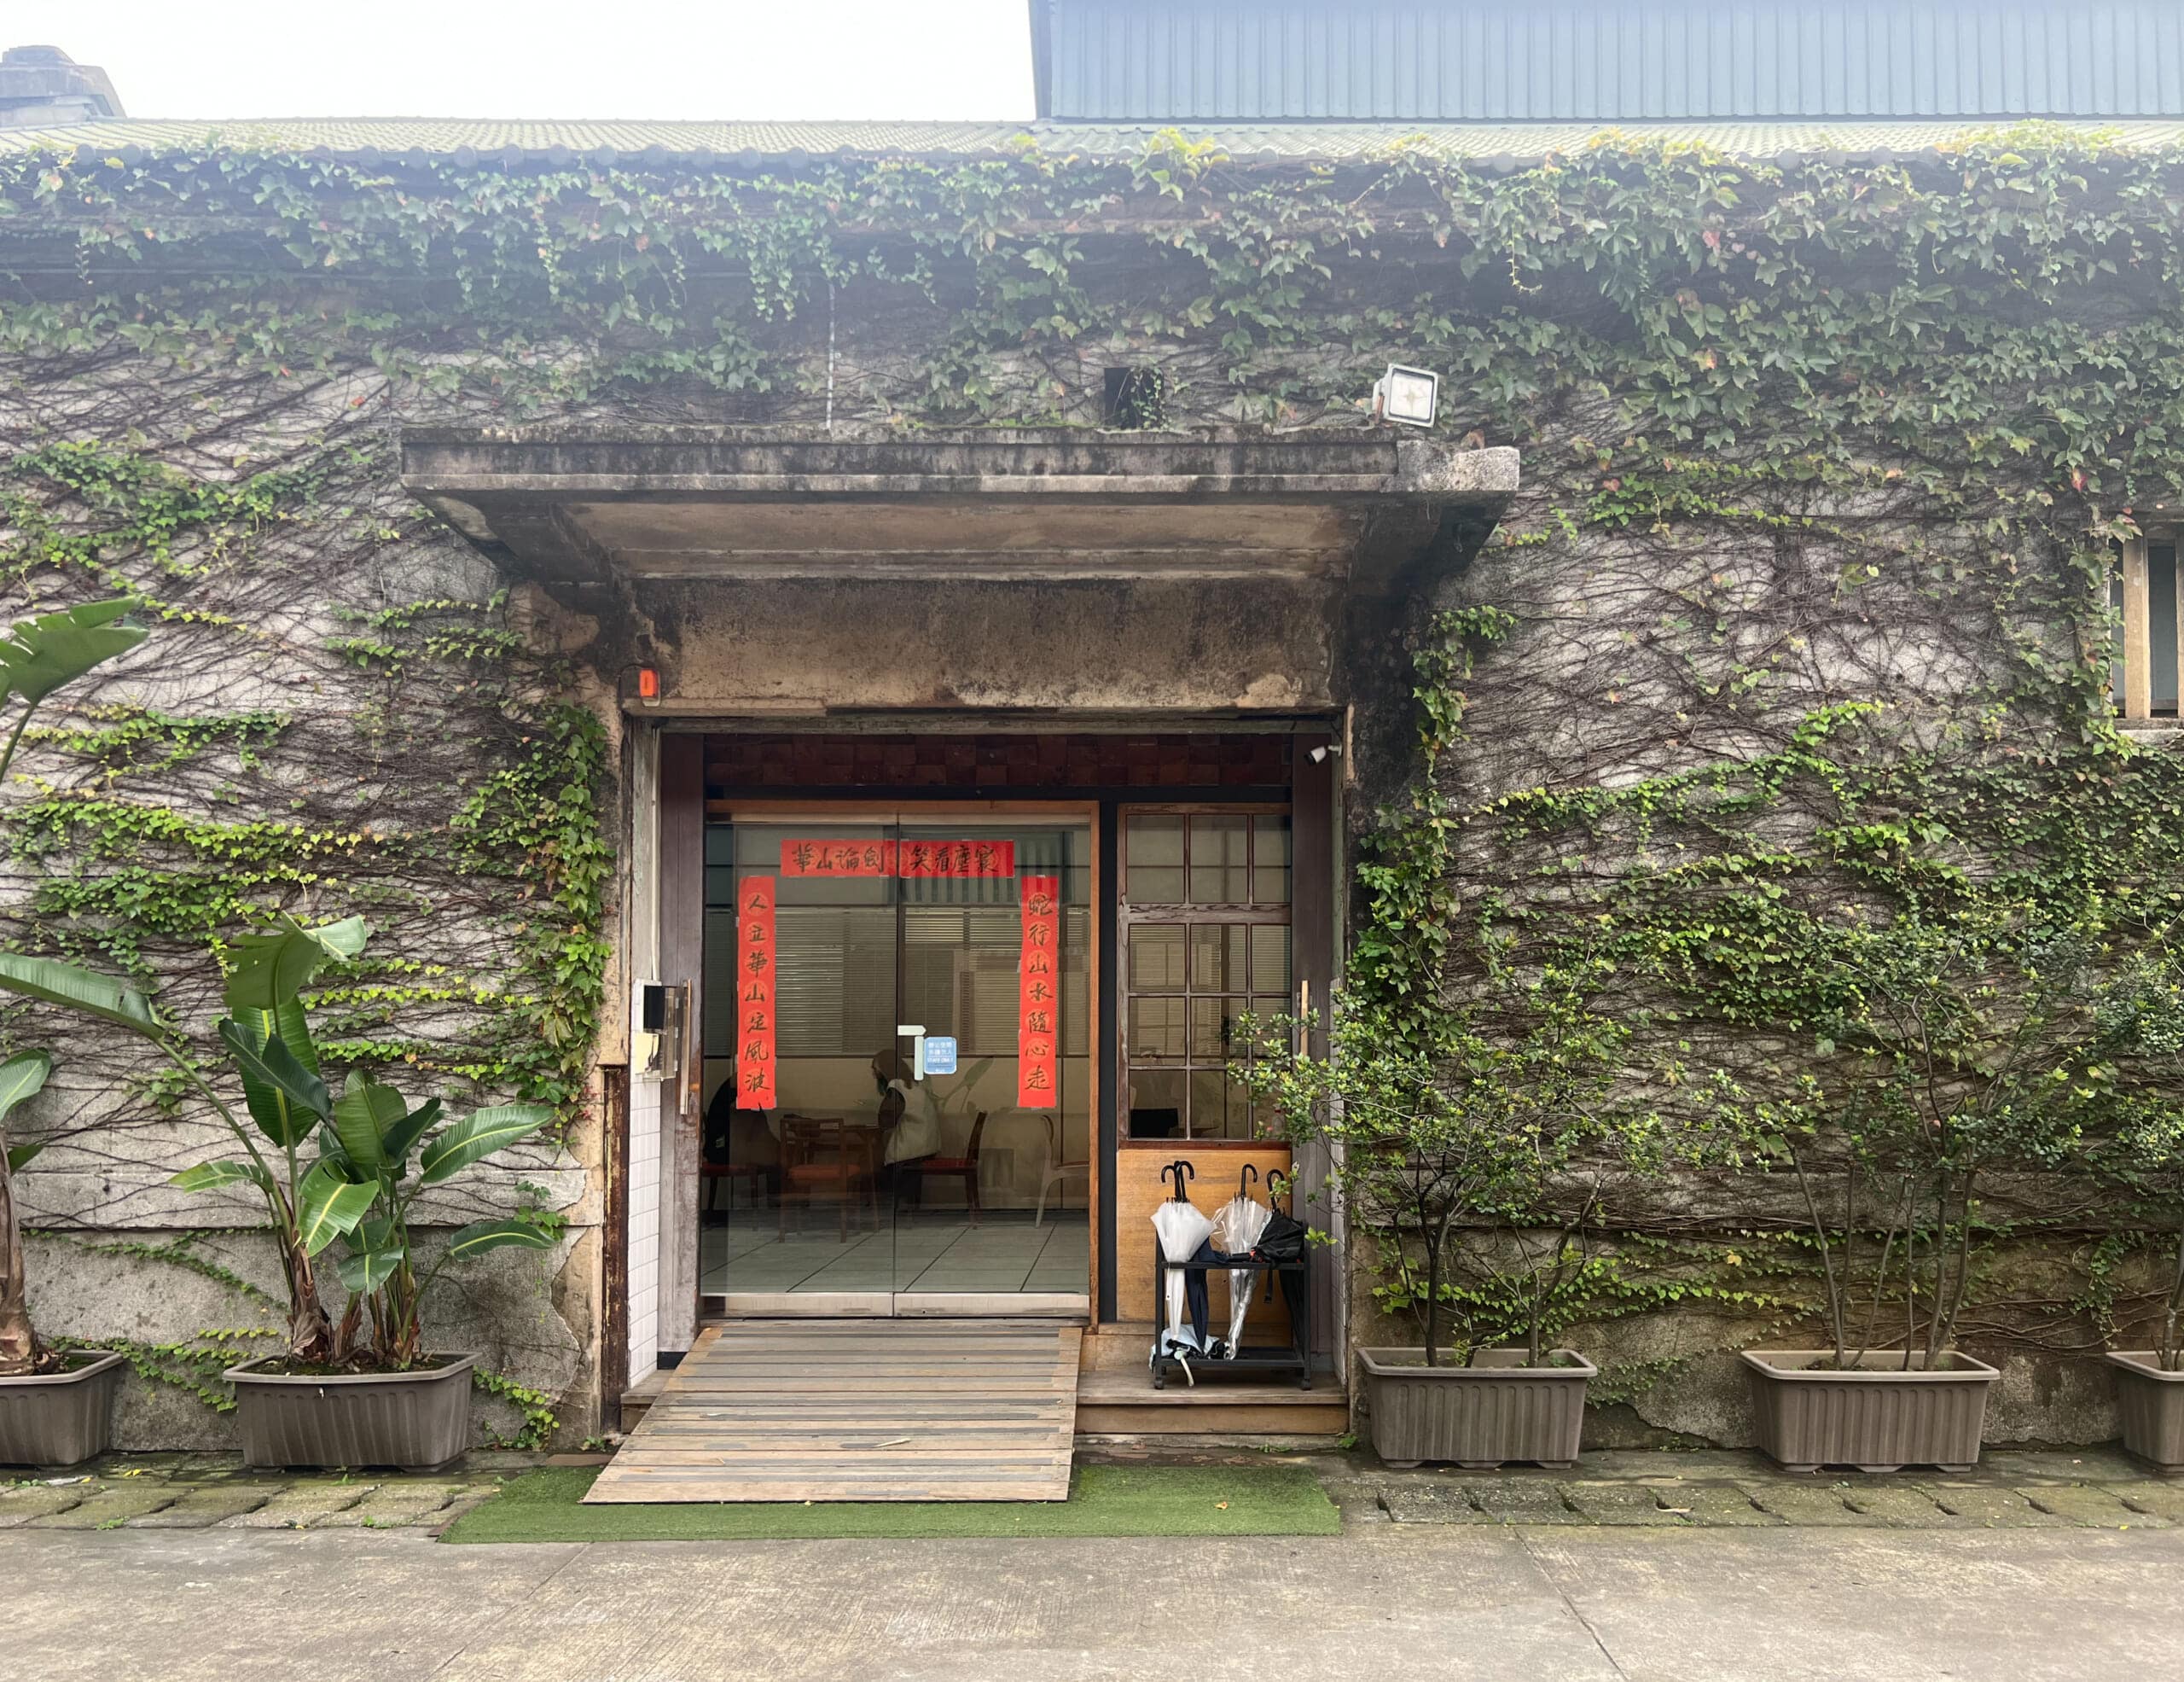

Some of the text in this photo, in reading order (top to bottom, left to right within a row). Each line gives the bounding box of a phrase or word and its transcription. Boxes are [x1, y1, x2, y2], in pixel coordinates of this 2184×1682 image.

[744, 894, 770, 1092] 人立華山定風波
[1025, 893, 1054, 1090] 蛇行山水隨心走
